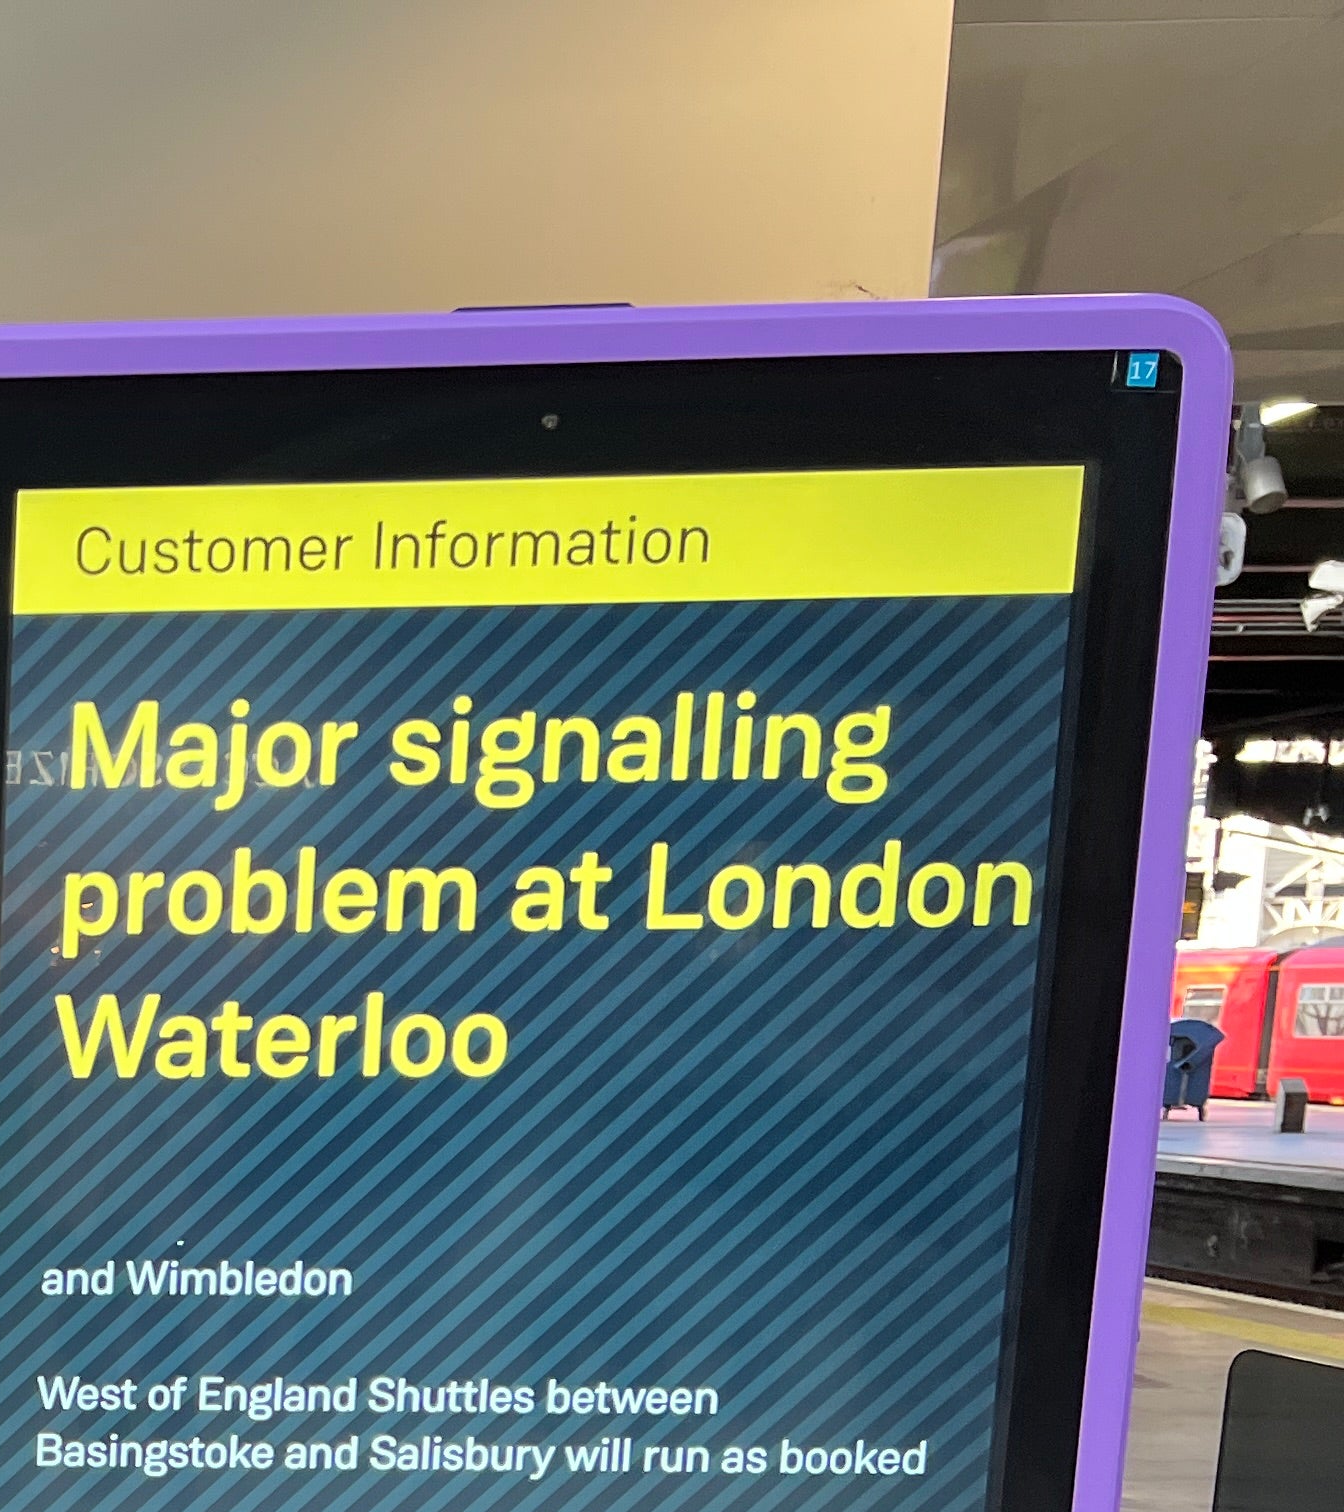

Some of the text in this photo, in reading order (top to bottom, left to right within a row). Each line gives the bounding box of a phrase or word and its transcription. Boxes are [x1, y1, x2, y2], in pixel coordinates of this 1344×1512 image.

[1130, 361, 1156, 379] 17
[78, 516, 708, 574] Customer Information
[70, 691, 890, 811] Major signalling
[60, 840, 1031, 958] problem at London
[55, 992, 507, 1078] Waterloo
[42, 1261, 351, 1295] and Wimbledon
[38, 1376, 717, 1420] West of England Shuttles between
[37, 1434, 926, 1479] Basingstoke and Salisbury will run as booked
